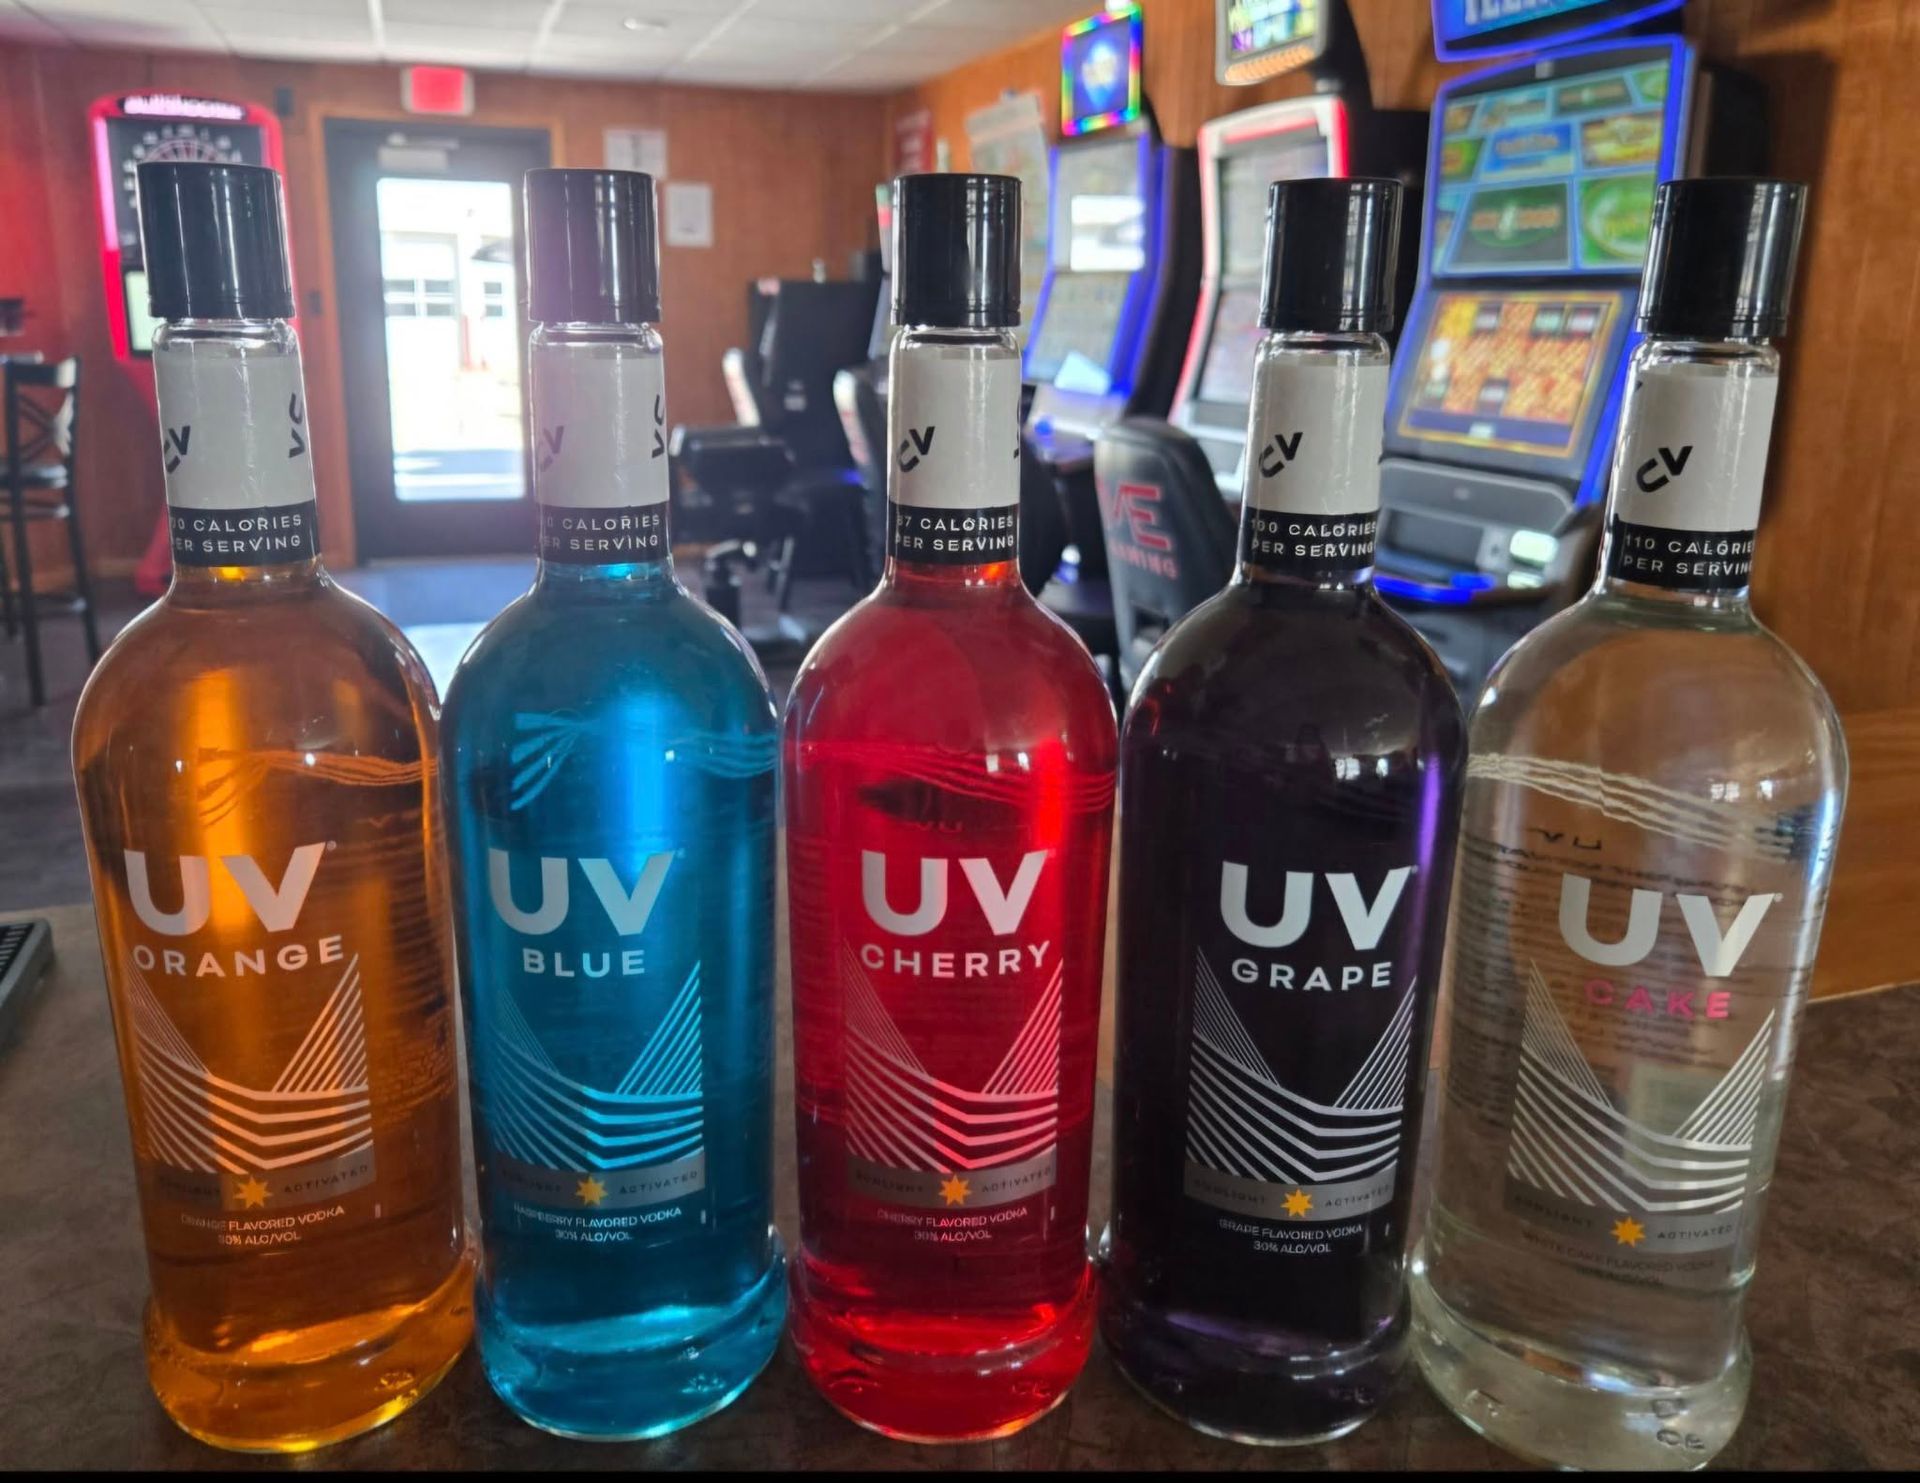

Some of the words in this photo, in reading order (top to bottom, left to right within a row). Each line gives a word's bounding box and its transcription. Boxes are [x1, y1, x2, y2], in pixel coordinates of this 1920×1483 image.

[896, 425, 936, 473] UV
[1258, 431, 1304, 478] UV
[1636, 445, 1694, 493] UV
[193, 513, 302, 533] CALORIES
[562, 513, 660, 531] CALORIES
[920, 515, 1015, 532] CALORIES
[201, 534, 301, 553] SERVING
[569, 533, 659, 552] SERVING
[933, 534, 1015, 552] SERVING
[1252, 539, 1285, 554] PER
[1295, 542, 1374, 558] SERVING
[1625, 534, 1656, 550] 110
[1624, 555, 1664, 573] PER
[123, 841, 326, 936] UV
[488, 847, 676, 937] UV
[861, 849, 1049, 937] UV
[1220, 860, 1412, 951] UV
[1559, 872, 1776, 978] UV
[133, 934, 344, 978] ORANGE
[522, 947, 646, 979] BLUE
[861, 940, 1050, 978] CHERRY
[1231, 958, 1393, 992] GRAPE
[1584, 978, 1732, 1020] CAKE
[618, 1170, 698, 1195] ACTIVATED
[228, 1217, 295, 1232] FLAVORED
[297, 1205, 345, 1226] VODKA
[575, 1216, 638, 1229] FLAVORED
[640, 1206, 682, 1224] VODKA
[926, 1215, 987, 1229] FLAVORED
[989, 1206, 1028, 1223] VODKA
[1261, 1227, 1324, 1241] FLAVORED
[1326, 1223, 1363, 1239] VODKA
[1657, 1224, 1734, 1241] ACTIVATED
[1253, 1241, 1279, 1253] 30%
[1280, 1243, 1332, 1255] ALC/VOL
